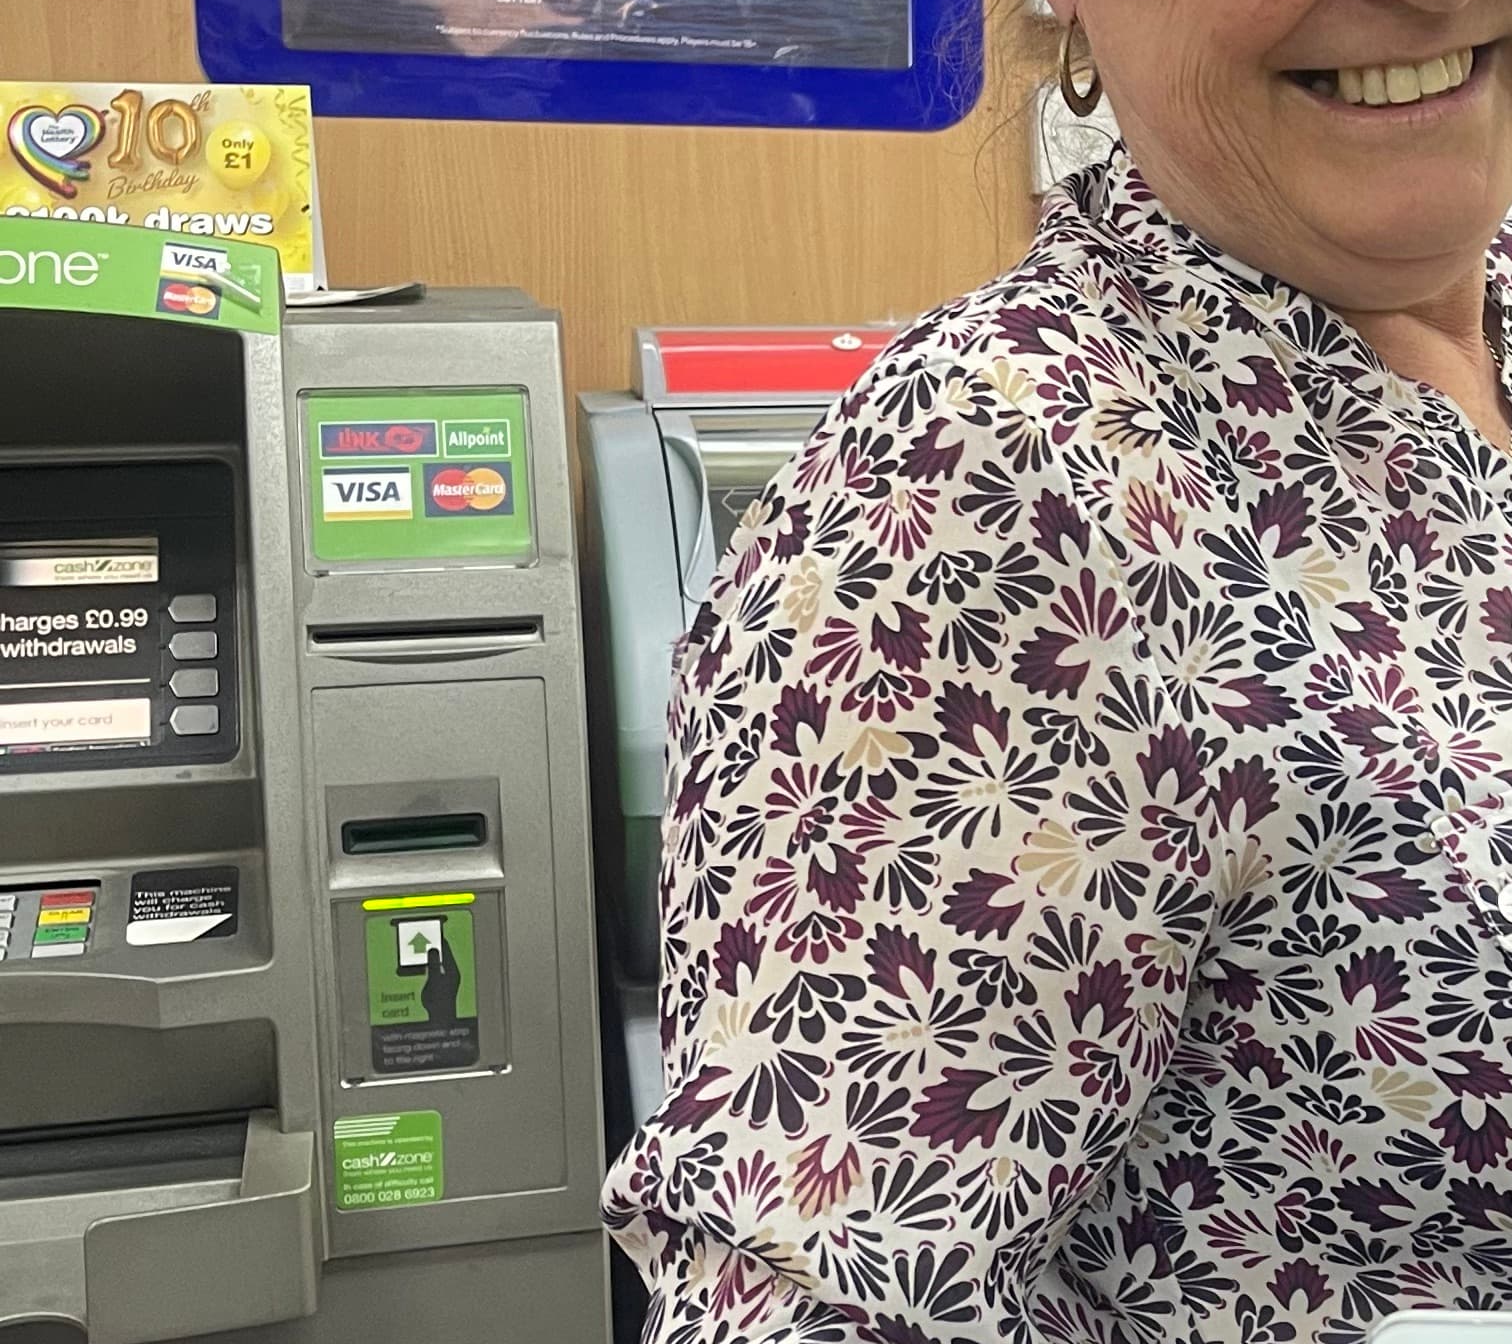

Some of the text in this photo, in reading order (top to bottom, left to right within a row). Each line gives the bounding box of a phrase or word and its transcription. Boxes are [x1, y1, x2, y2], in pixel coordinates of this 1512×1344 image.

[221, 137, 255, 151] Only
[224, 152, 252, 170] £1
[106, 168, 200, 200] Birthday
[145, 207, 274, 235] draws
[173, 251, 218, 271] VISA
[449, 425, 506, 448] Allpoint
[331, 481, 507, 505] VISA MasterCard
[54, 559, 153, 574] cash zone
[85, 608, 148, 629] £0.99
[0, 635, 137, 657] withdrawals
[42, 713, 112, 731] your card
[134, 894, 213, 906] will charge
[135, 885, 232, 899] This machine
[133, 899, 225, 915] you for cash
[382, 1006, 410, 1017] card
[342, 1153, 432, 1169] cash zone
[344, 1187, 435, 1204] 0800 028 6923
